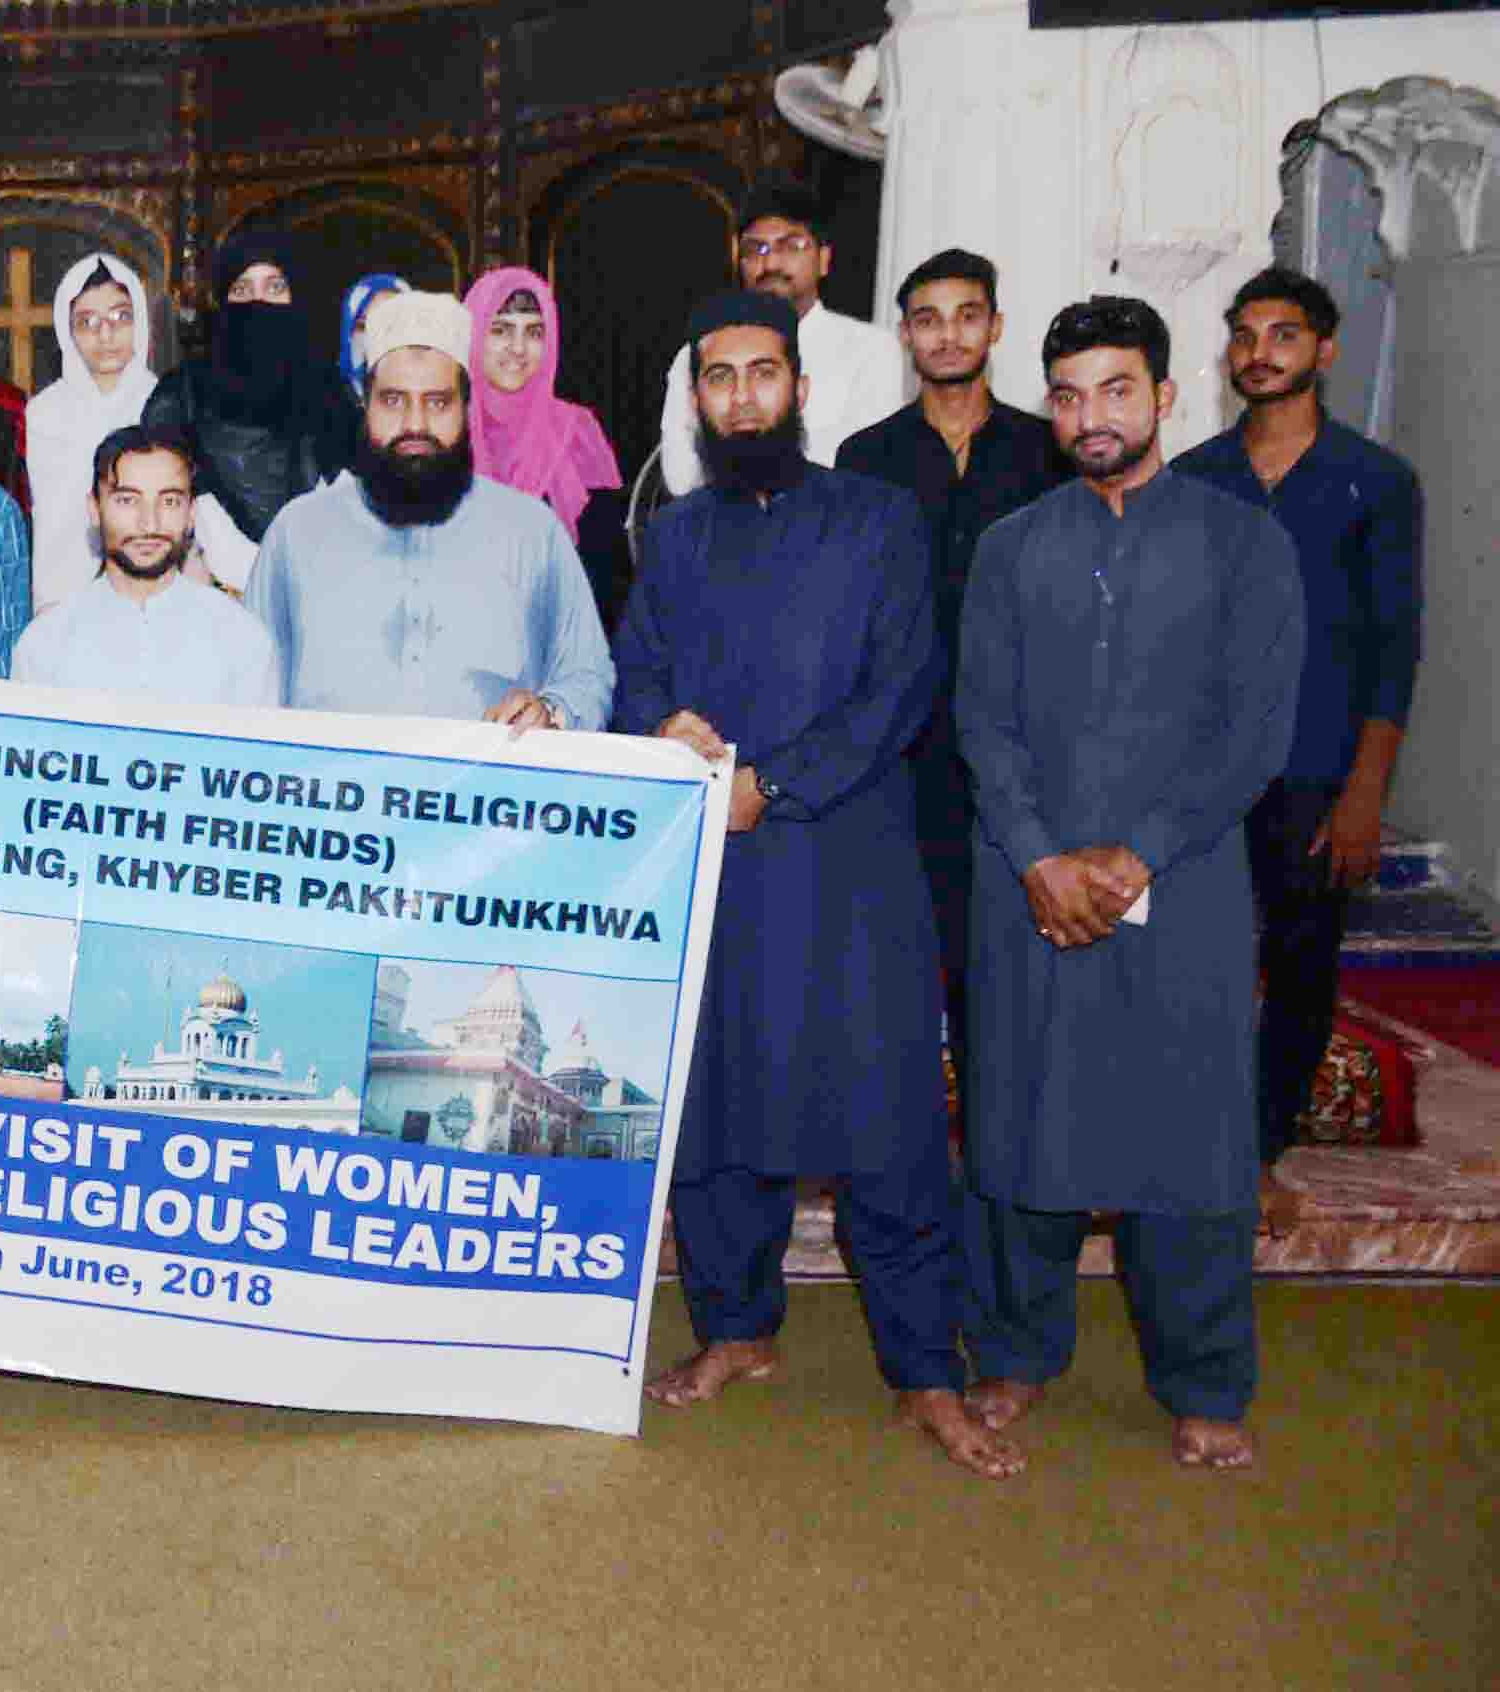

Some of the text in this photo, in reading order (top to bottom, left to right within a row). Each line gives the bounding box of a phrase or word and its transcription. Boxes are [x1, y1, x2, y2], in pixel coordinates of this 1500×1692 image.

[23, 797, 397, 874] (FAITH FRIENDS)
[125, 757, 186, 793] OF
[200, 765, 366, 813] WORLD
[380, 785, 638, 840] RELIGIONS
[97, 854, 282, 904] KHYBER
[297, 877, 662, 944] PAKHTUNKHWA
[161, 1132, 257, 1185] OF
[274, 1144, 557, 1230] WOMEN,
[19, 1244, 143, 1296] June,
[160, 1262, 274, 1307] 2018
[309, 1210, 627, 1279] LEADERS
